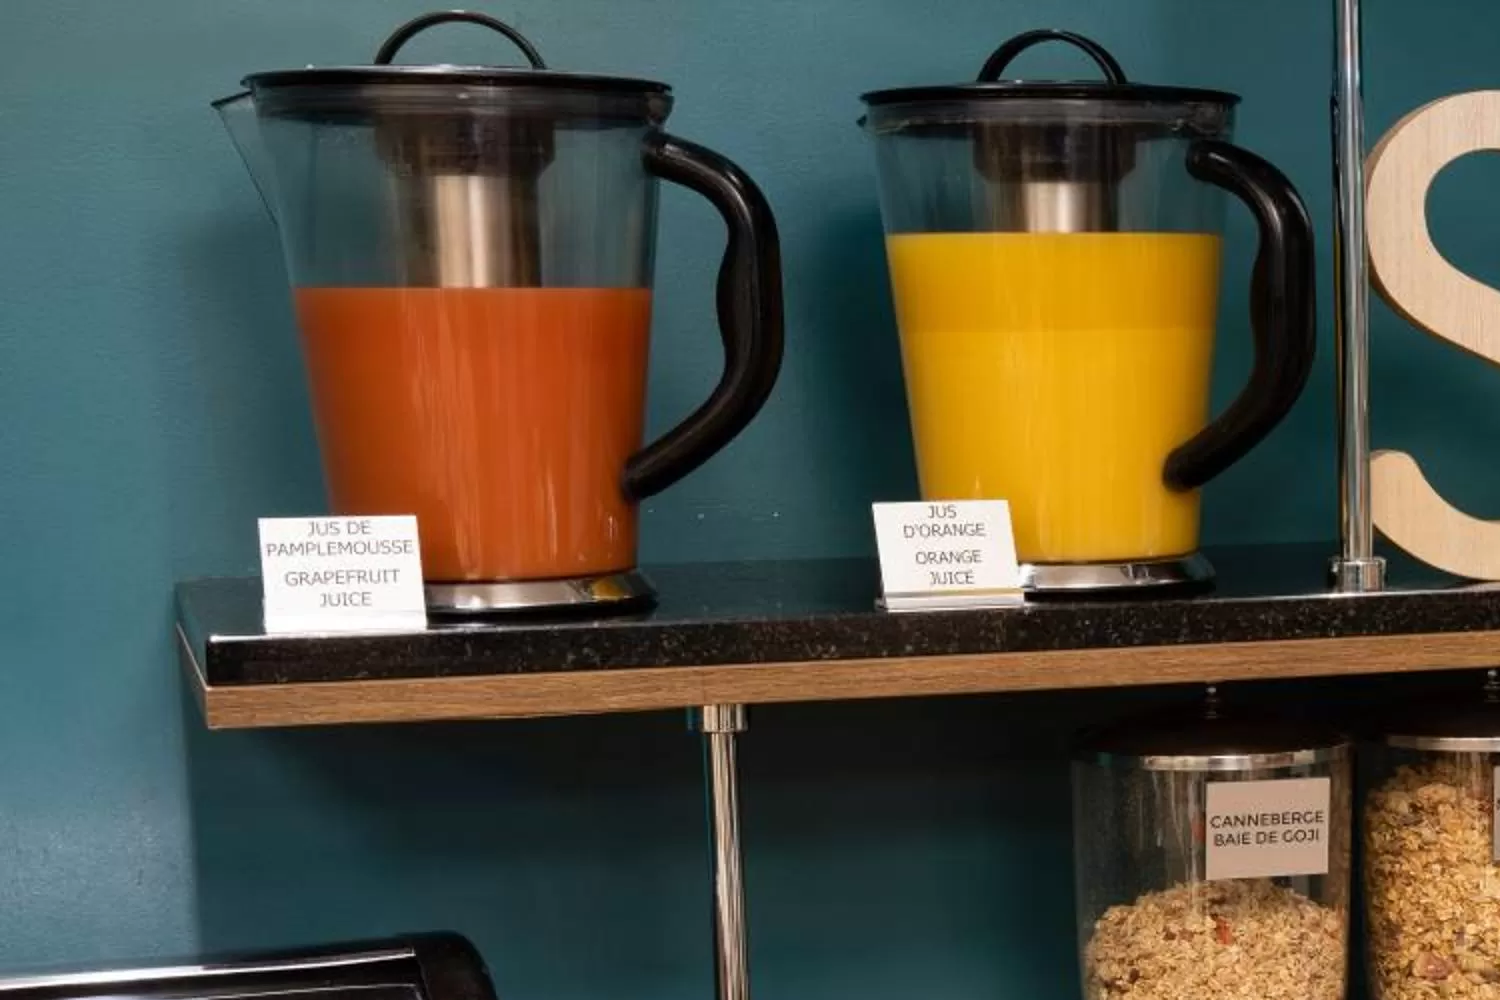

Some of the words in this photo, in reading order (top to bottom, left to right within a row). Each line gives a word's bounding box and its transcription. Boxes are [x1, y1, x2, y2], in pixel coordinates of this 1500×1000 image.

[927, 505, 957, 519] JUS
[308, 521, 341, 536] JUS
[347, 520, 371, 534] DE
[903, 523, 986, 539] D'ORANGE
[266, 540, 414, 557] PAMPLEMOUSSE
[915, 549, 982, 565] ORANGE
[284, 569, 400, 586] GRAPEFRUIT
[930, 570, 975, 585] JUICE
[320, 591, 372, 607] JUICE
[1209, 811, 1325, 829] CANNEBERGE
[1214, 832, 1252, 847] BAIE
[1255, 830, 1278, 845] DE
[1282, 828, 1319, 843] GOJI
